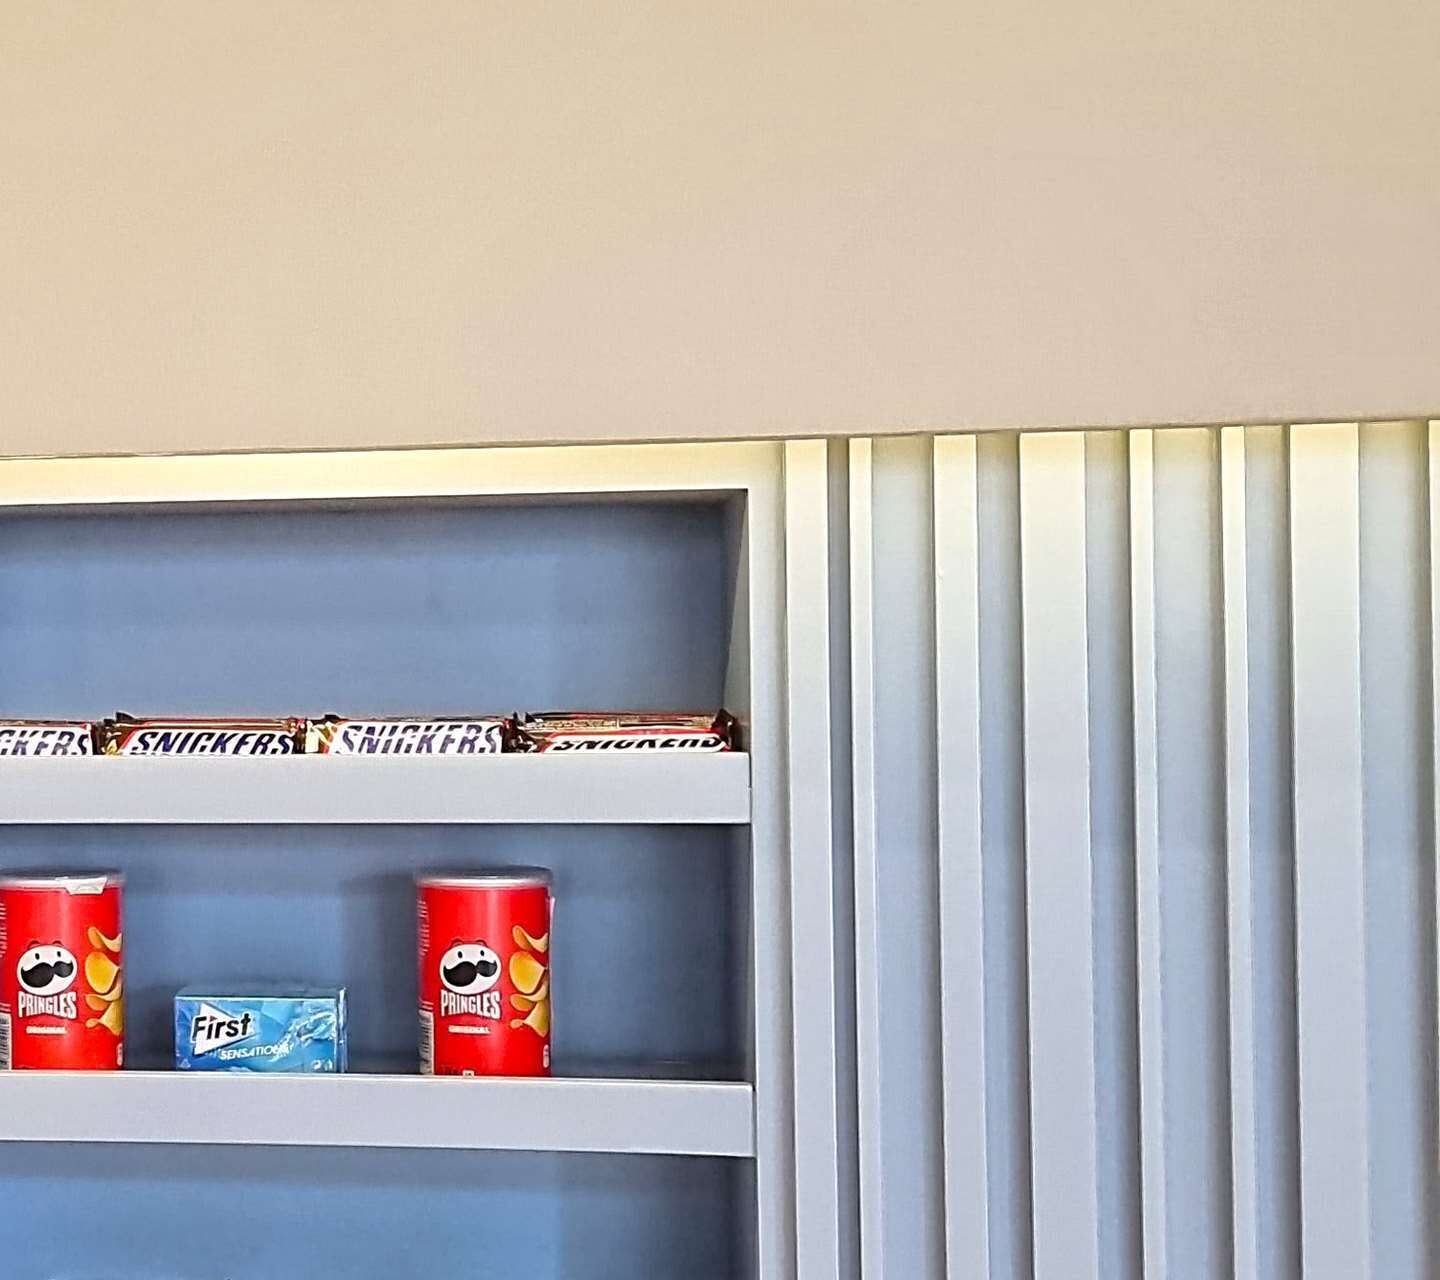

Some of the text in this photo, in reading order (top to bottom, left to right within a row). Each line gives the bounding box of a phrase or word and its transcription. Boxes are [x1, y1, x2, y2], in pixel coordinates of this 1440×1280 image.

[18, 991, 77, 1020] PRINGLES
[440, 989, 501, 1019] PRINGLES
[192, 1013, 252, 1041] First
